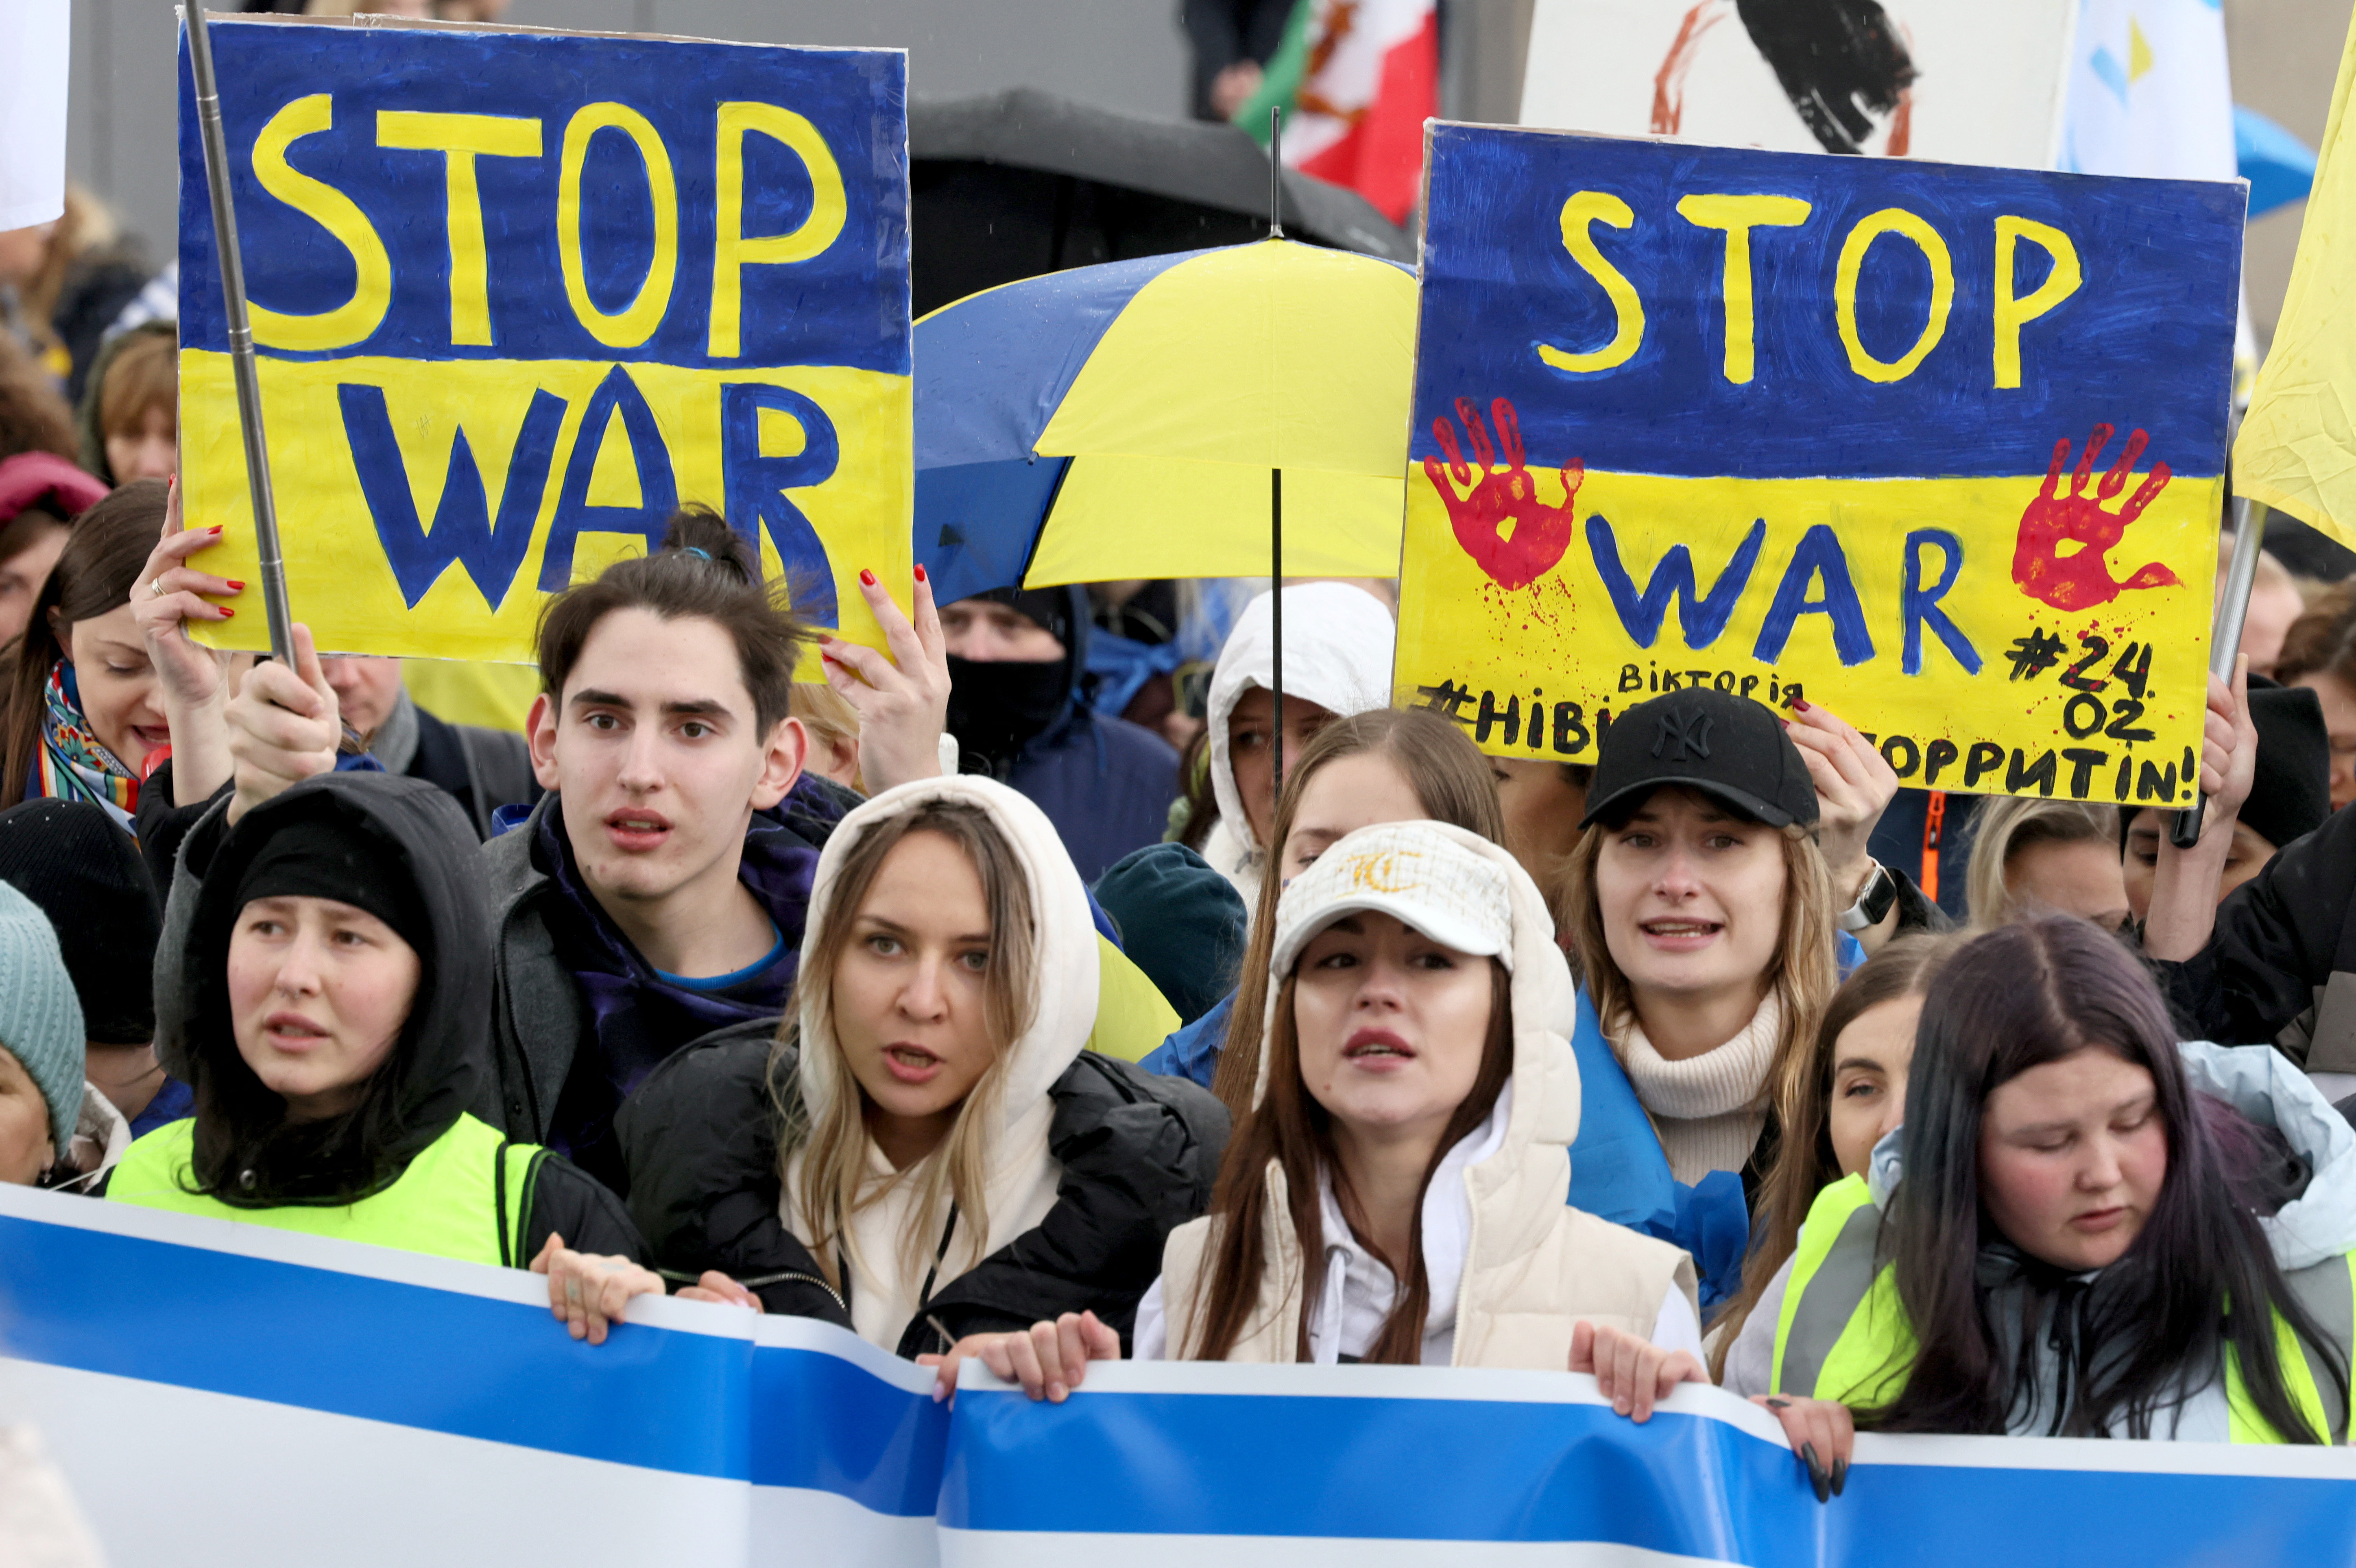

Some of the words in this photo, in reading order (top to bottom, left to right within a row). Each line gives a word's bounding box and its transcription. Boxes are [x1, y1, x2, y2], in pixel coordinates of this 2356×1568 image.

[245, 93, 847, 359] STOP
[1536, 190, 2082, 389] STOP
[337, 363, 839, 630] WAR
[1584, 514, 1985, 676] WAR
[1651, 706, 1715, 761] NY
